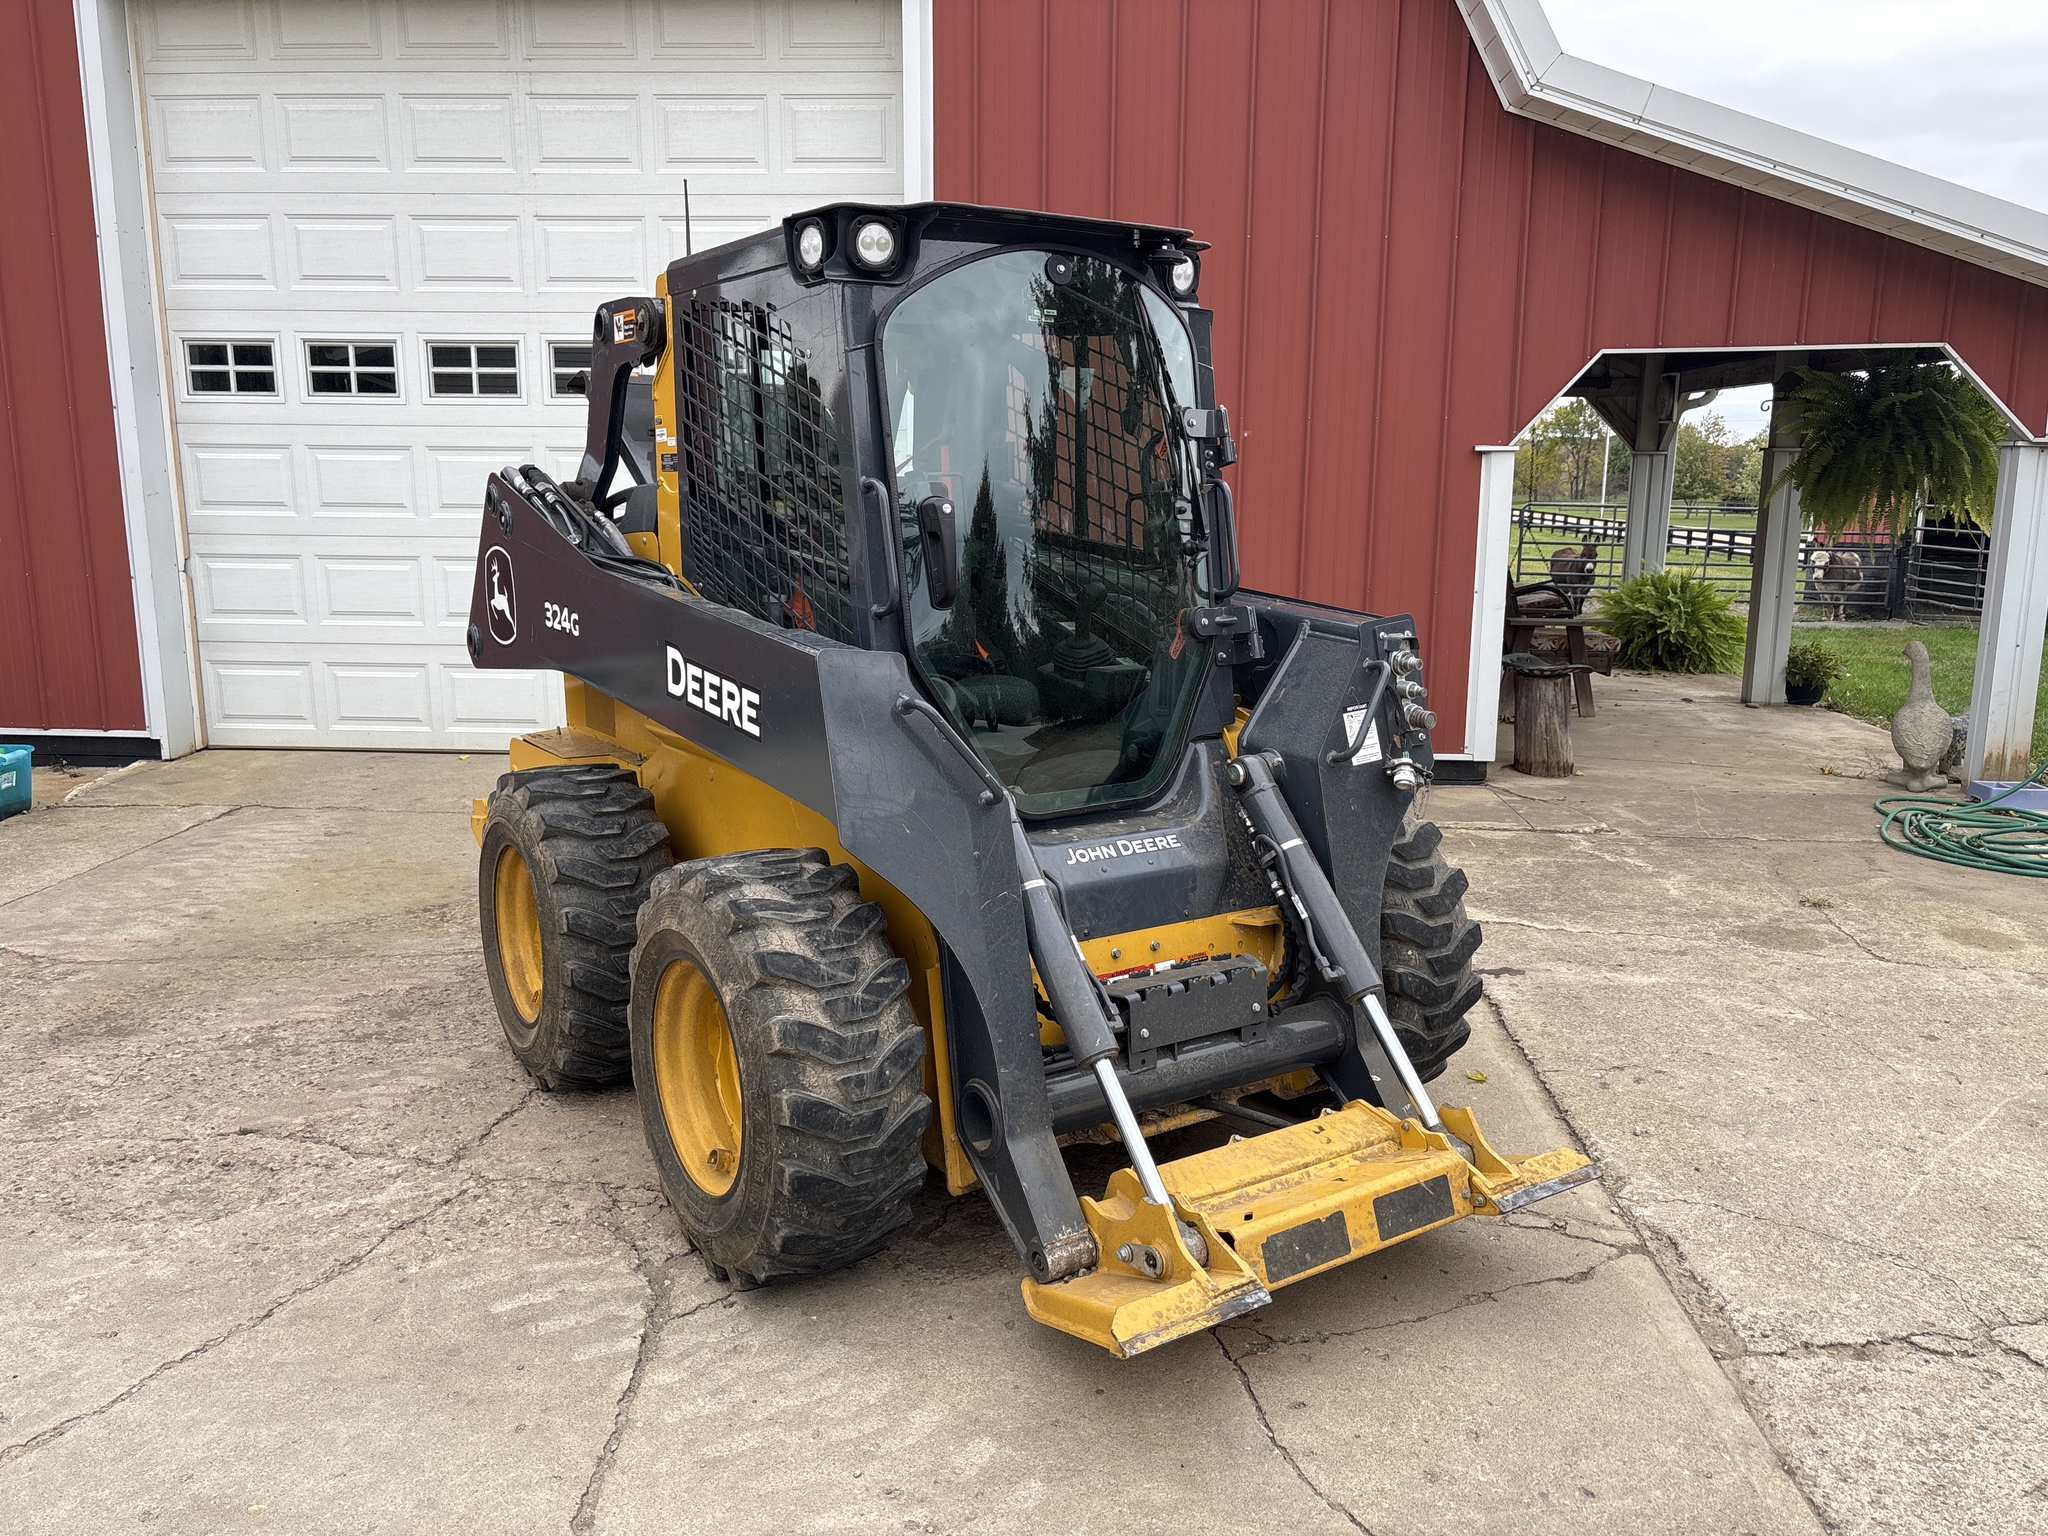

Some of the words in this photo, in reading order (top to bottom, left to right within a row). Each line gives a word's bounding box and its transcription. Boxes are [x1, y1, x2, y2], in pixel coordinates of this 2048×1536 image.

[544, 601, 580, 637] 324G
[666, 645, 761, 737] DEERE
[1066, 844, 1118, 865] JOHN
[1116, 834, 1182, 856] DEERE
[1187, 951, 1207, 960] WARNING
